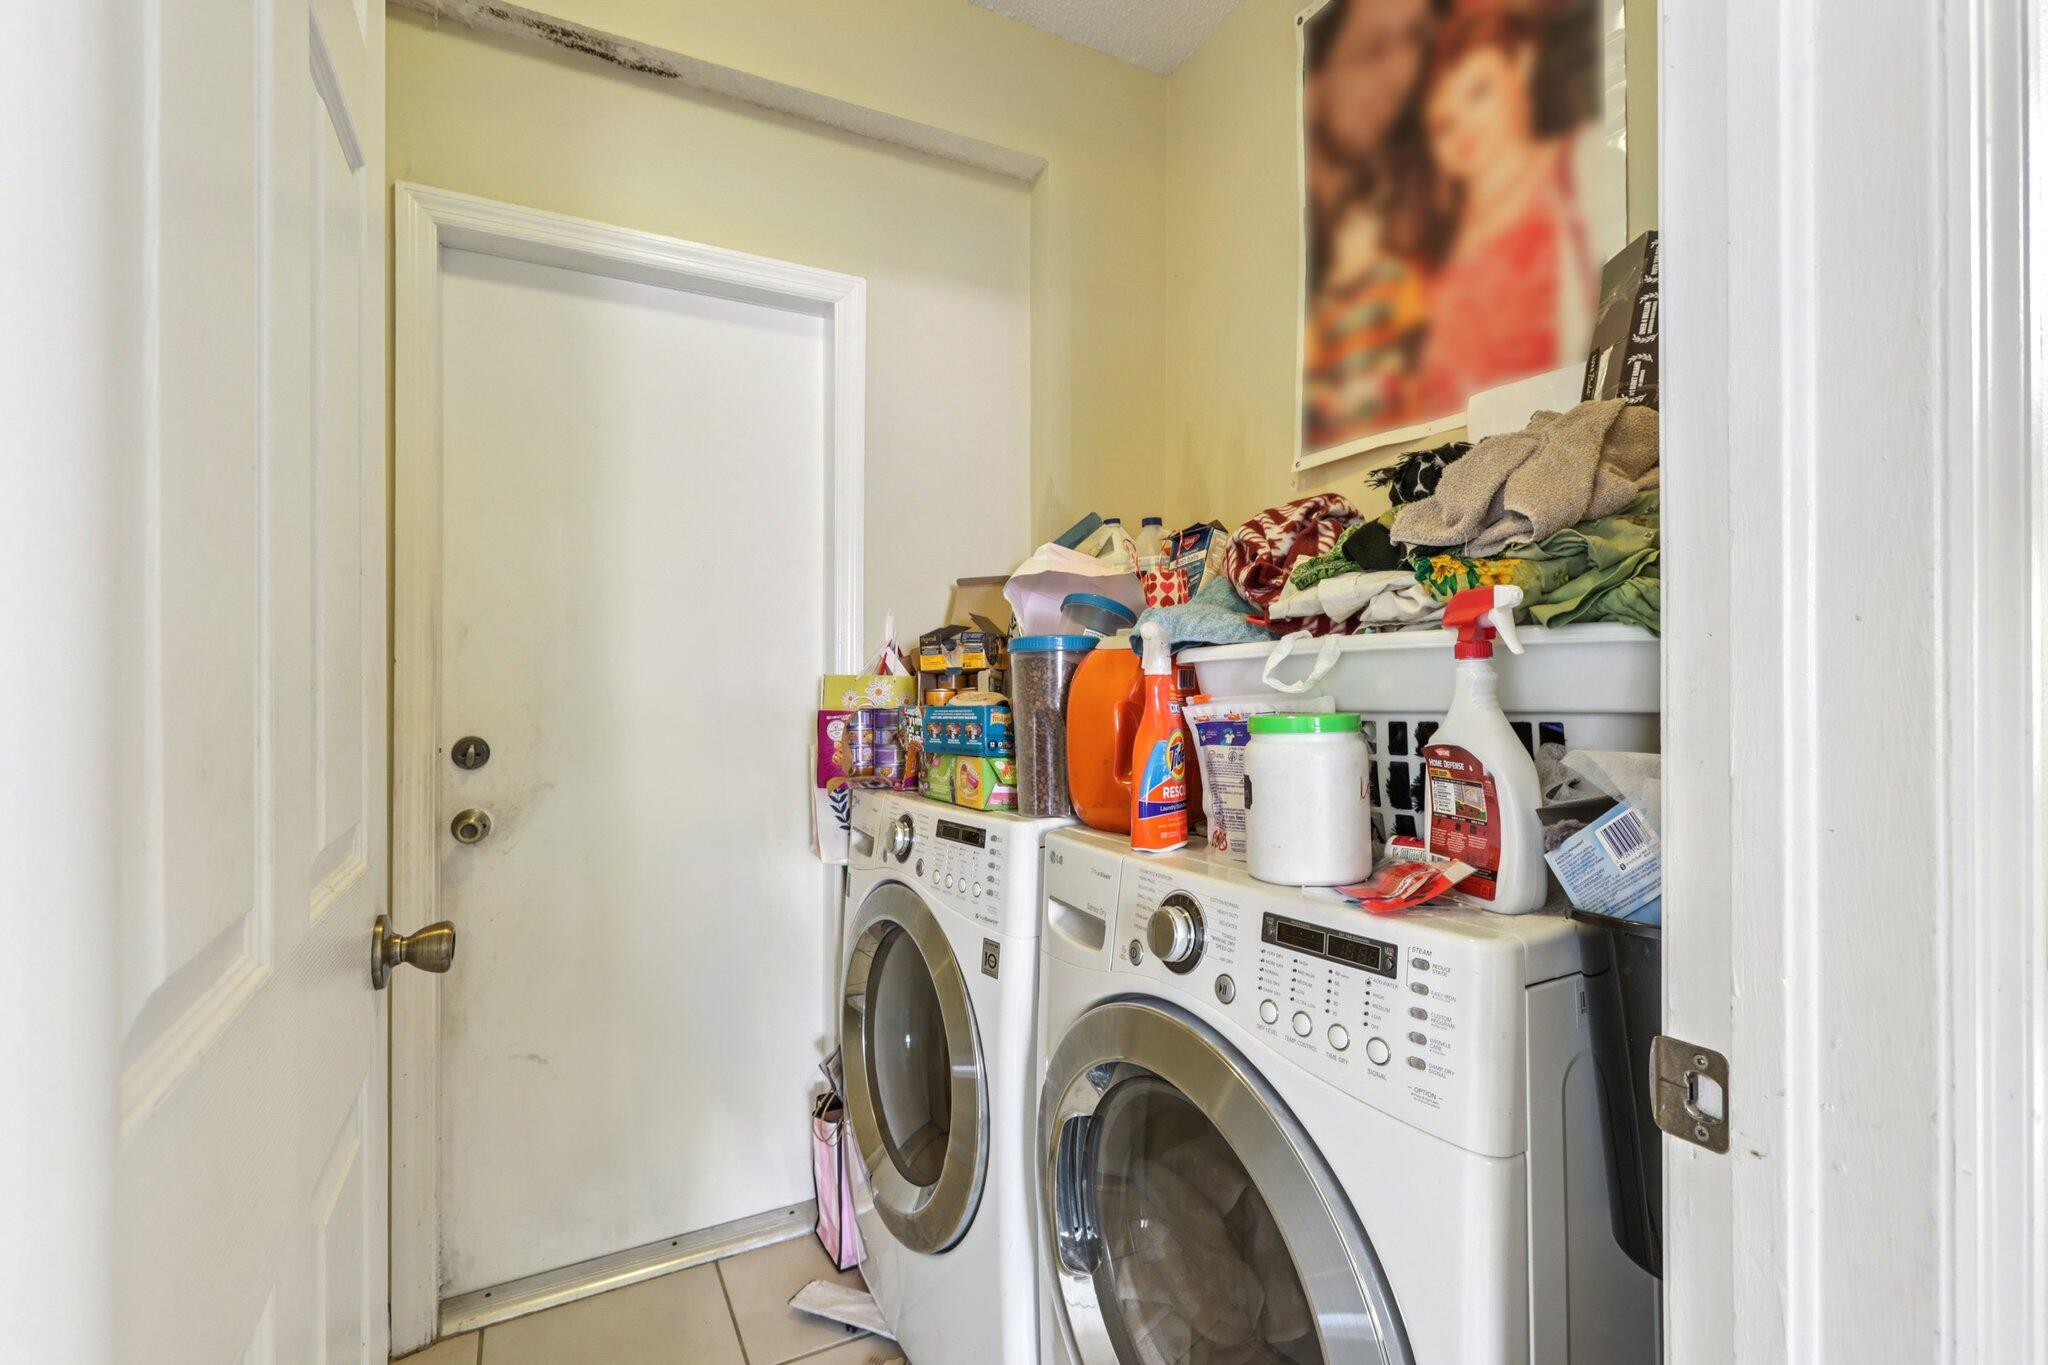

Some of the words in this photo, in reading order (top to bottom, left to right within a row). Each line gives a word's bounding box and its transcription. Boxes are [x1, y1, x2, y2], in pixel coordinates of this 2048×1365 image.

[1429, 758, 1444, 768] HOME
[1443, 759, 1465, 771] DEFENSE
[1412, 946, 1432, 957] STEAM
[1367, 1068, 1388, 1081] SIGNAL
[1413, 1086, 1437, 1100] OPTION
